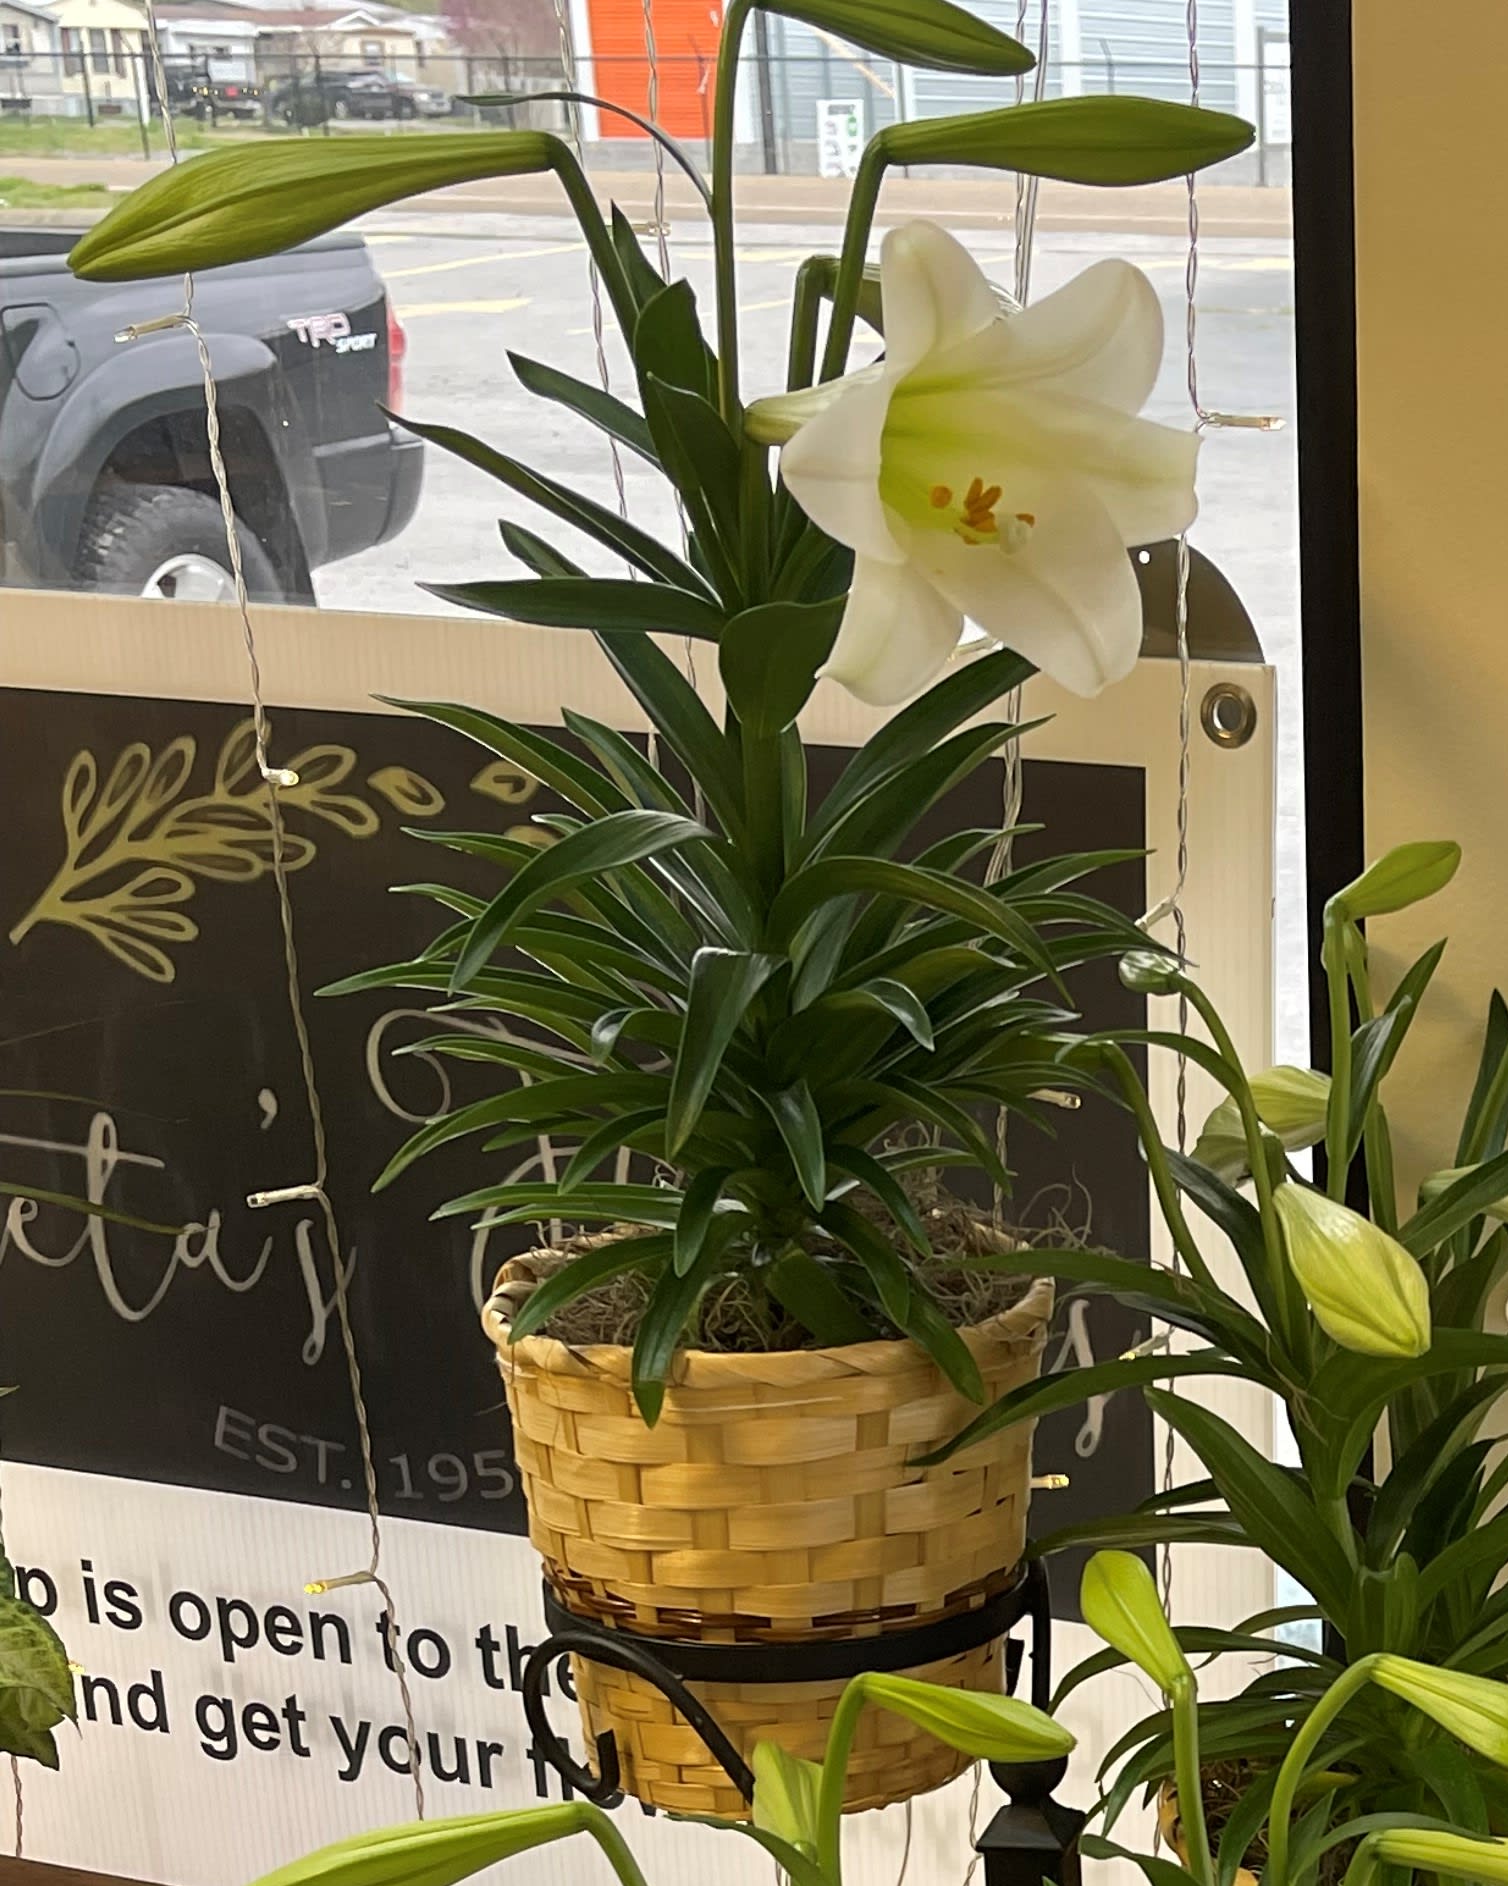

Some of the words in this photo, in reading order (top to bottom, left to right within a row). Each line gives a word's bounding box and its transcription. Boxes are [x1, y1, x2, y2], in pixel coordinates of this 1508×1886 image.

[0, 1087, 358, 1366] eta's
[213, 1405, 353, 1490] EST.
[388, 1449, 516, 1501] 195
[80, 1558, 143, 1631] is
[168, 1590, 353, 1664] open
[375, 1609, 451, 1679] to
[80, 1669, 170, 1734] nd
[195, 1693, 311, 1761] get
[329, 1715, 504, 1789] your
